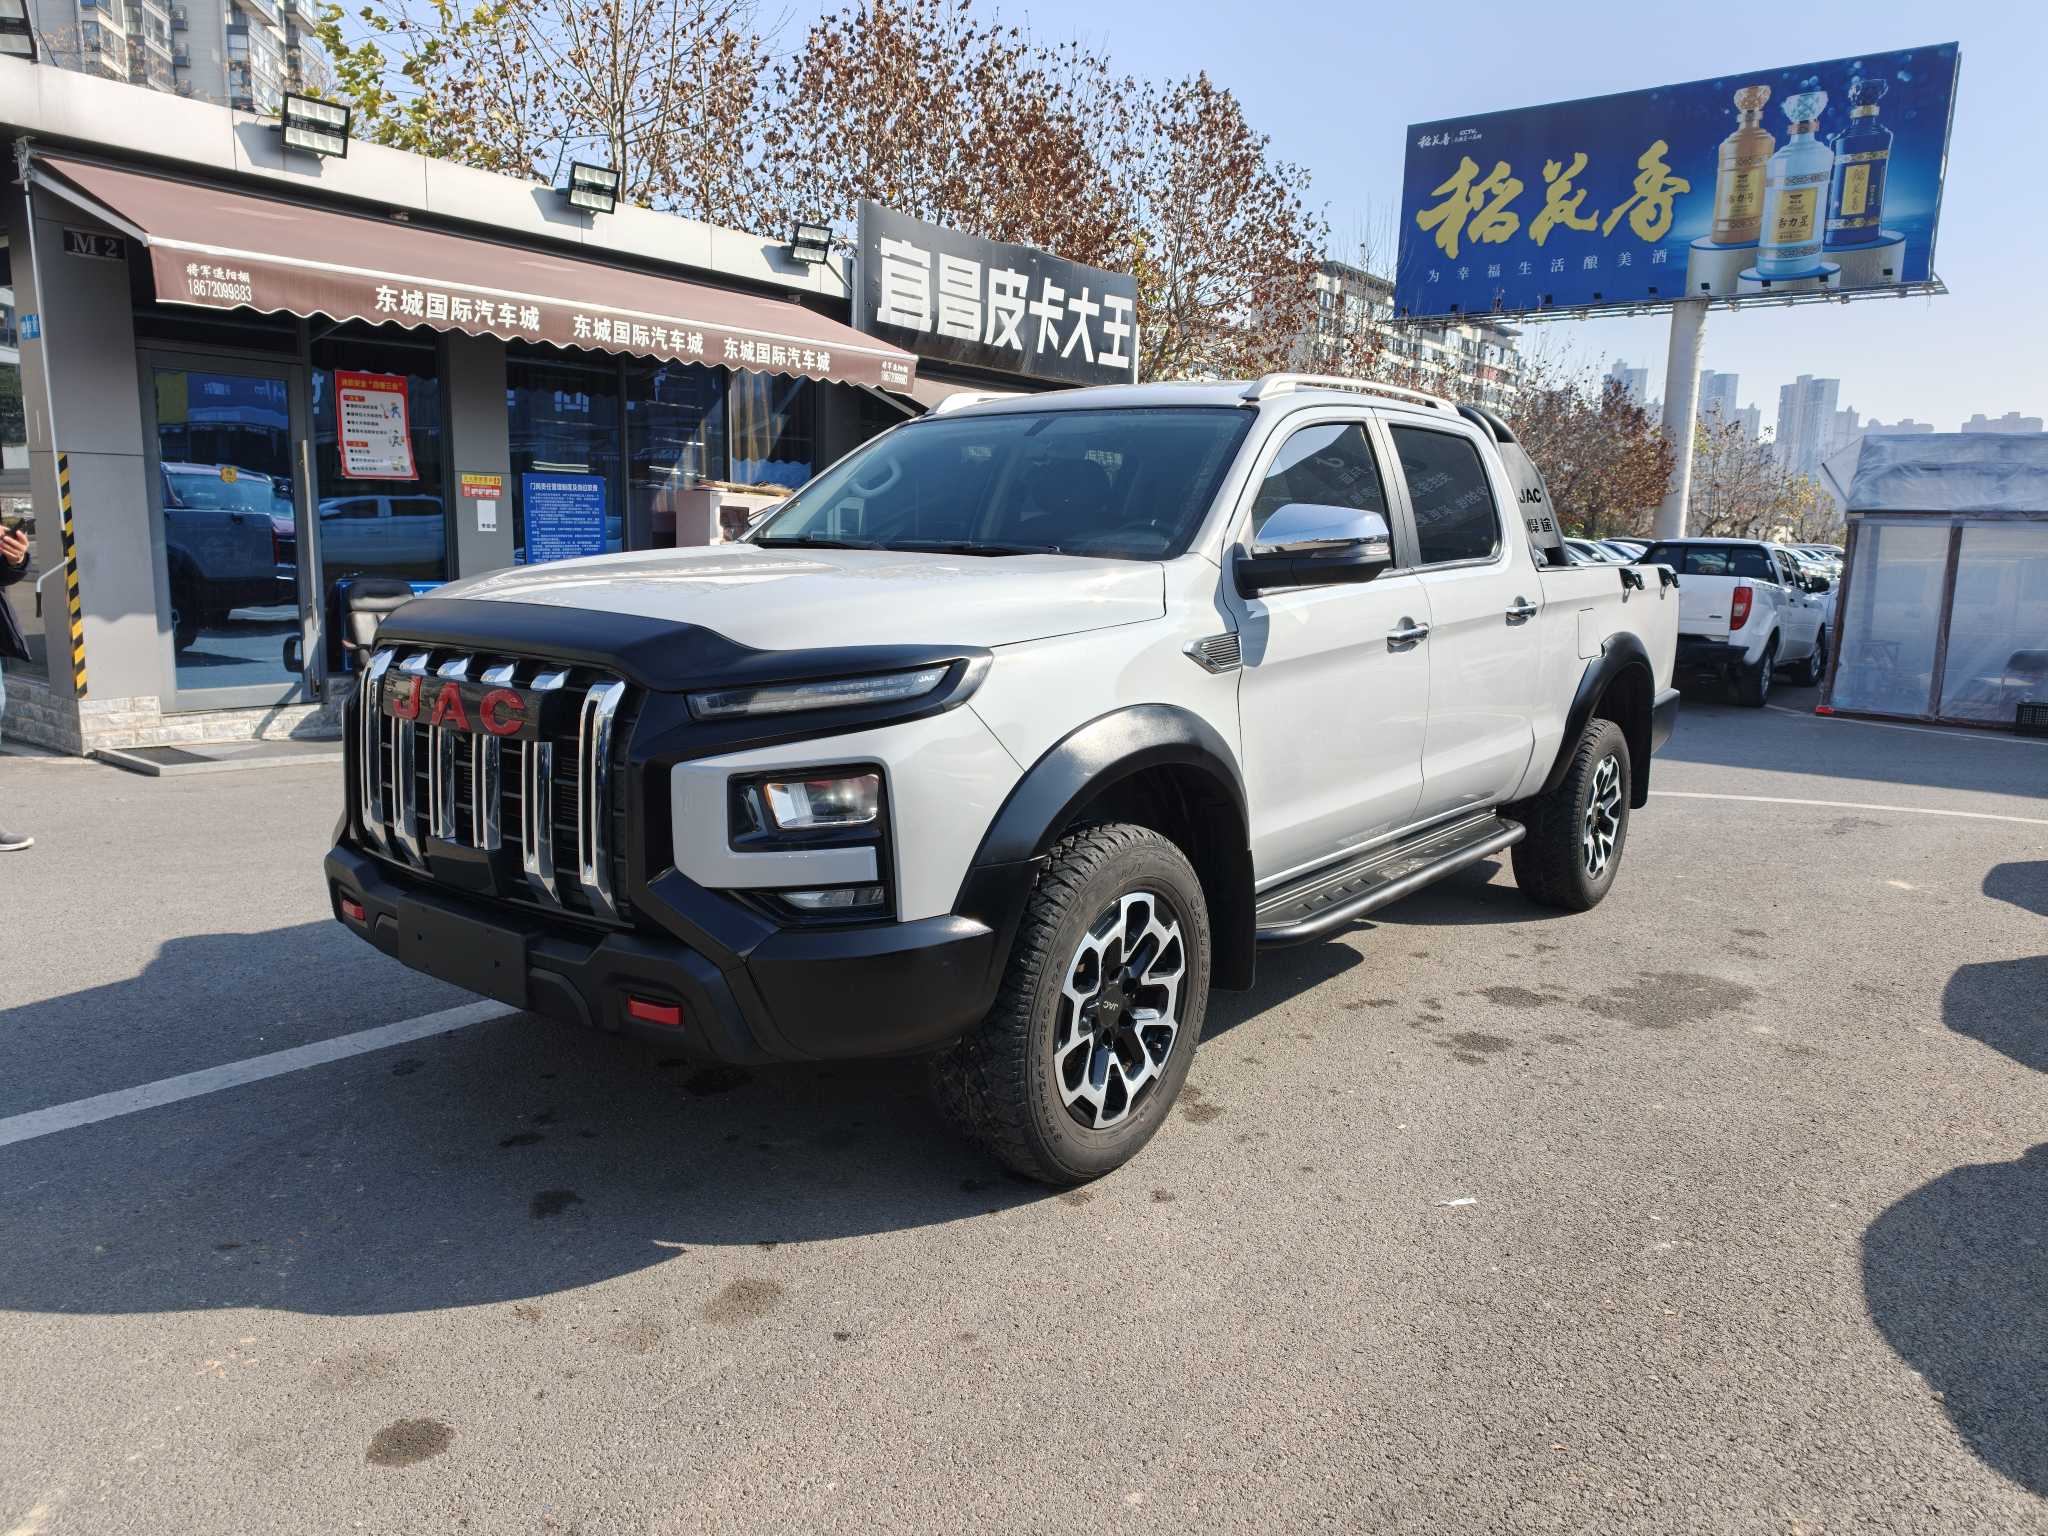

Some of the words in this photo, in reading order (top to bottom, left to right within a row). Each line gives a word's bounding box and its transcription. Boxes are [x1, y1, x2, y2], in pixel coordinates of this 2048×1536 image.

[1416, 139, 1691, 260] 稻花香
[73, 232, 96, 255] M
[104, 239, 118, 257] 2
[1427, 248, 1668, 283] 为幸福生活酿美酒
[187, 279, 252, 302] 18672099883
[375, 285, 540, 332] 东城国际汽车城
[877, 236, 1133, 369] 宜昌皮卡大王
[573, 314, 704, 354] 东城国际汽车城
[723, 336, 831, 373] 东城国际汽车城
[1519, 488, 1542, 504] JAC
[391, 675, 527, 737] JAC
